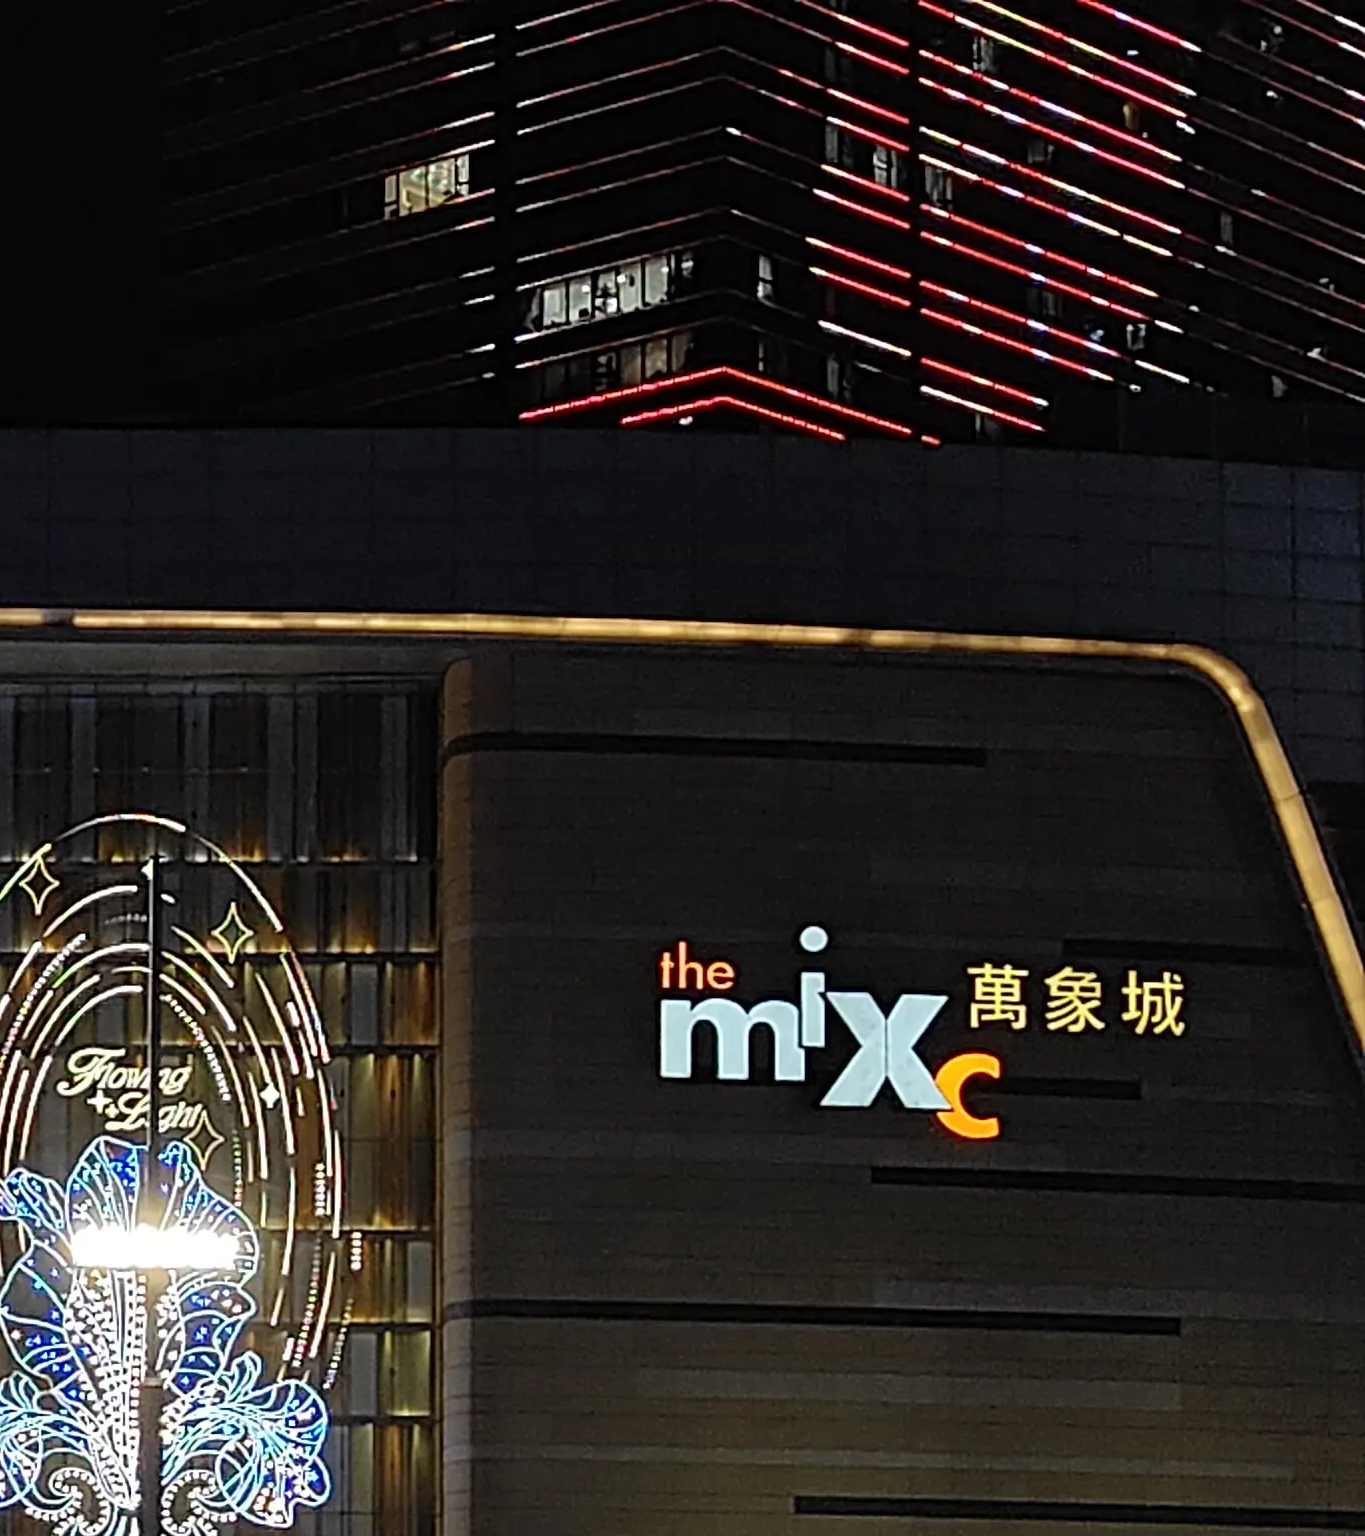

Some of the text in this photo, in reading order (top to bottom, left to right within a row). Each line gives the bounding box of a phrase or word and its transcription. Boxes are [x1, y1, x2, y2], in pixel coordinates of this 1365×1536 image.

[660, 942, 736, 990] the
[967, 963, 1187, 1038] 萬象城
[56, 1047, 193, 1097] Flowng
[105, 1092, 203, 1134] Lght
